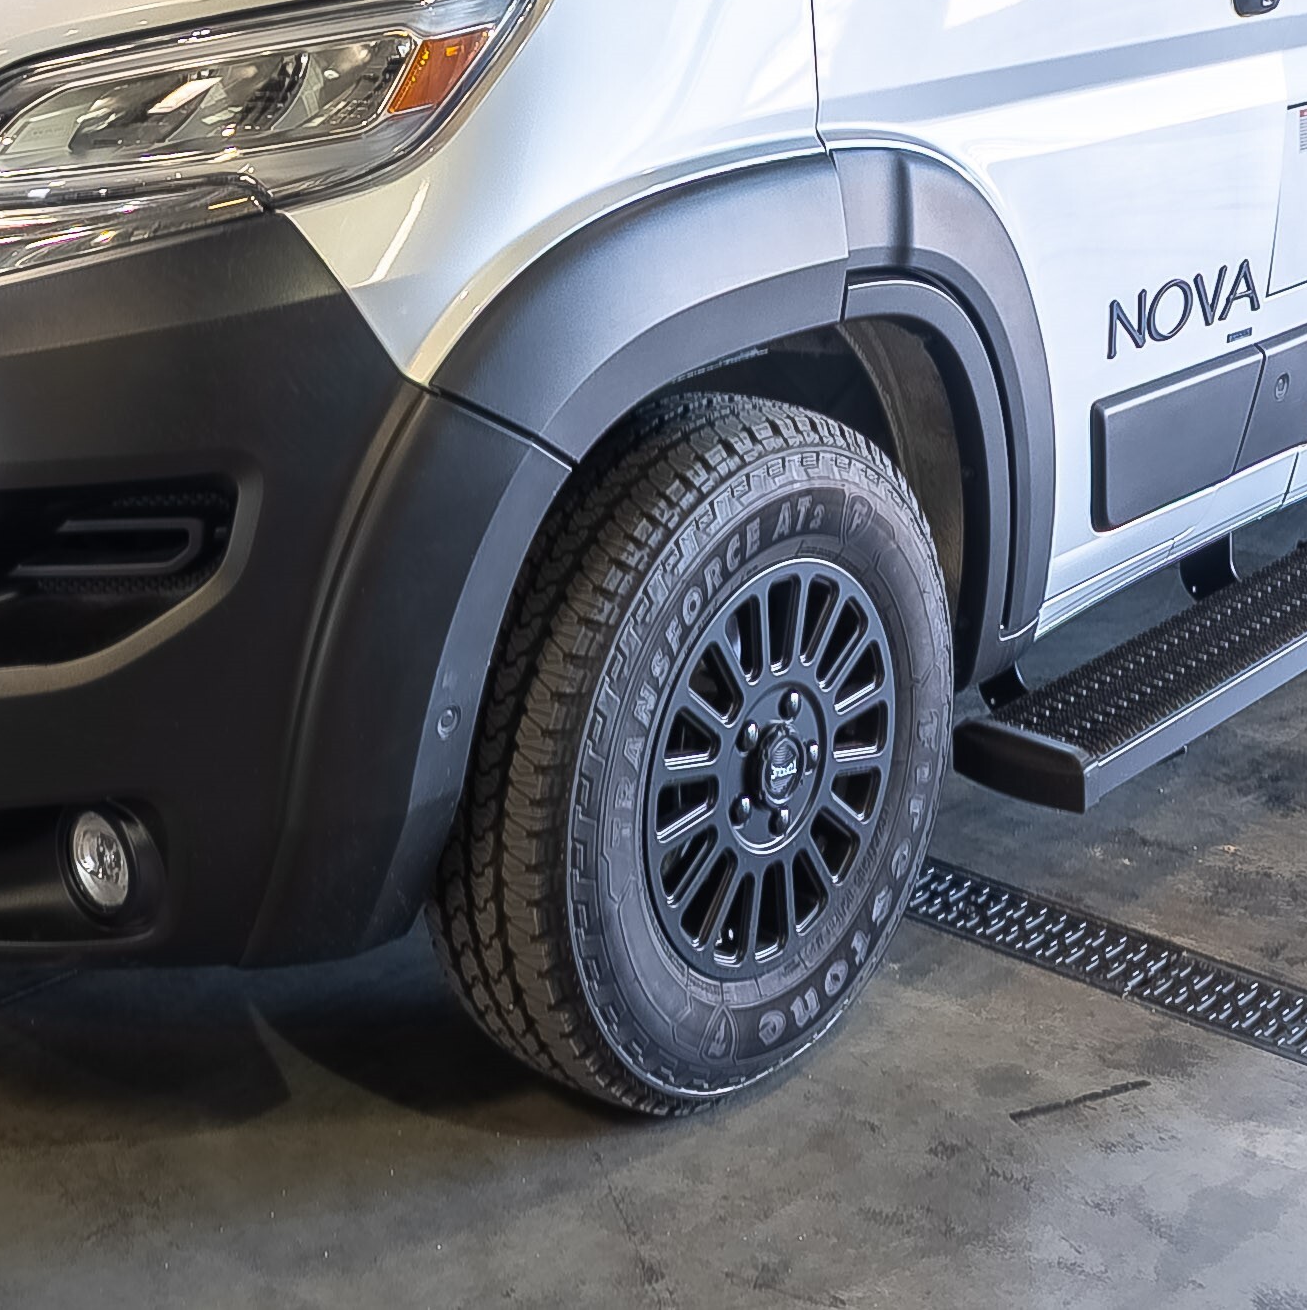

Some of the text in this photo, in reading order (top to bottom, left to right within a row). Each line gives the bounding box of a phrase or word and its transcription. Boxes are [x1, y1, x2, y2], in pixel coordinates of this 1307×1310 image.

[1107, 259, 1260, 359] NOVA
[611, 520, 761, 846] TRANSFORCE
[758, 709, 940, 1046] Firestone
